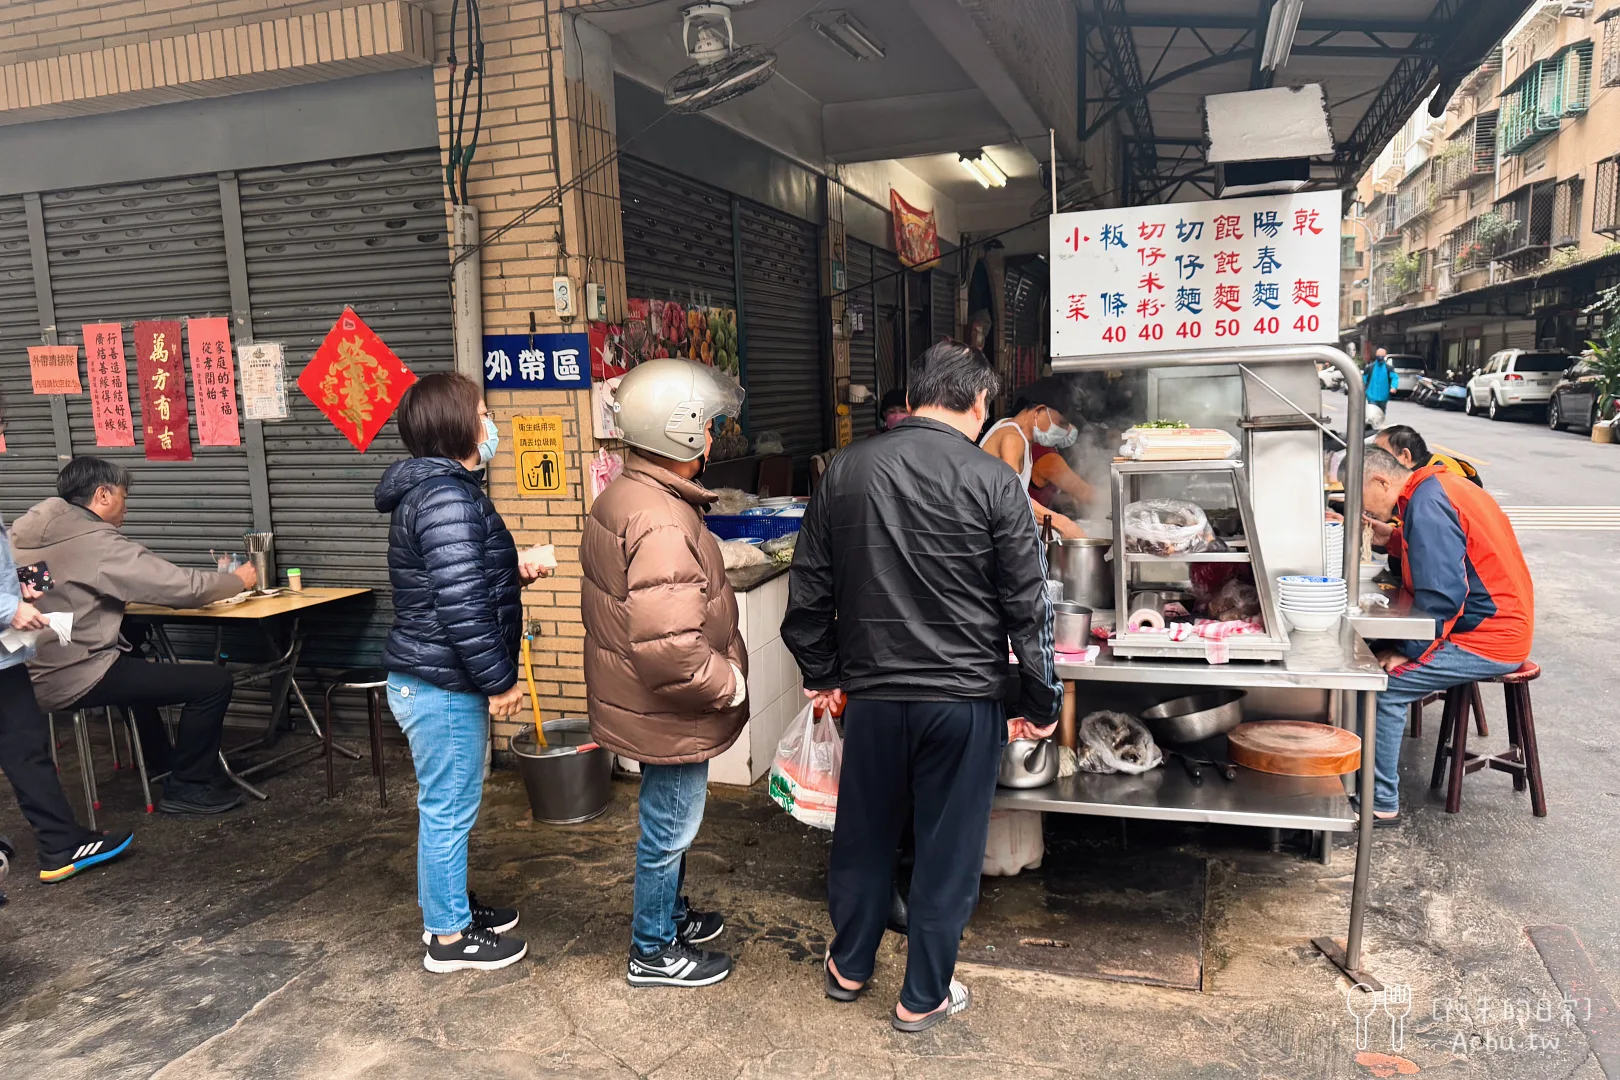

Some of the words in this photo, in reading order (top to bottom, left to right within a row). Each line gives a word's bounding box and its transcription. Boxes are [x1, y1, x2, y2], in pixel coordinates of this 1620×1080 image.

[1065, 227, 1090, 321] 小菜
[1136, 221, 1166, 319] 切仔米粉
[1175, 218, 1205, 315] 切仔麵
[1212, 214, 1244, 313] 餛飩麵
[1252, 210, 1284, 310] 陽春麵
[1291, 208, 1324, 308] 乾麵
[1102, 326, 1126, 343] 40
[1138, 324, 1164, 341] 40
[1176, 321, 1202, 339] 40
[1215, 319, 1241, 337] 50
[1253, 317, 1280, 335] 40
[1293, 315, 1320, 333] 40
[107, 332, 128, 431] 行善造福結好緣
[149, 332, 174, 450] 萬方有吉
[202, 342, 217, 400] 從孝開始
[215, 340, 232, 415] 家庭的幸福
[485, 348, 581, 381] 外帶區
[518, 423, 556, 432] 衛生紙用完
